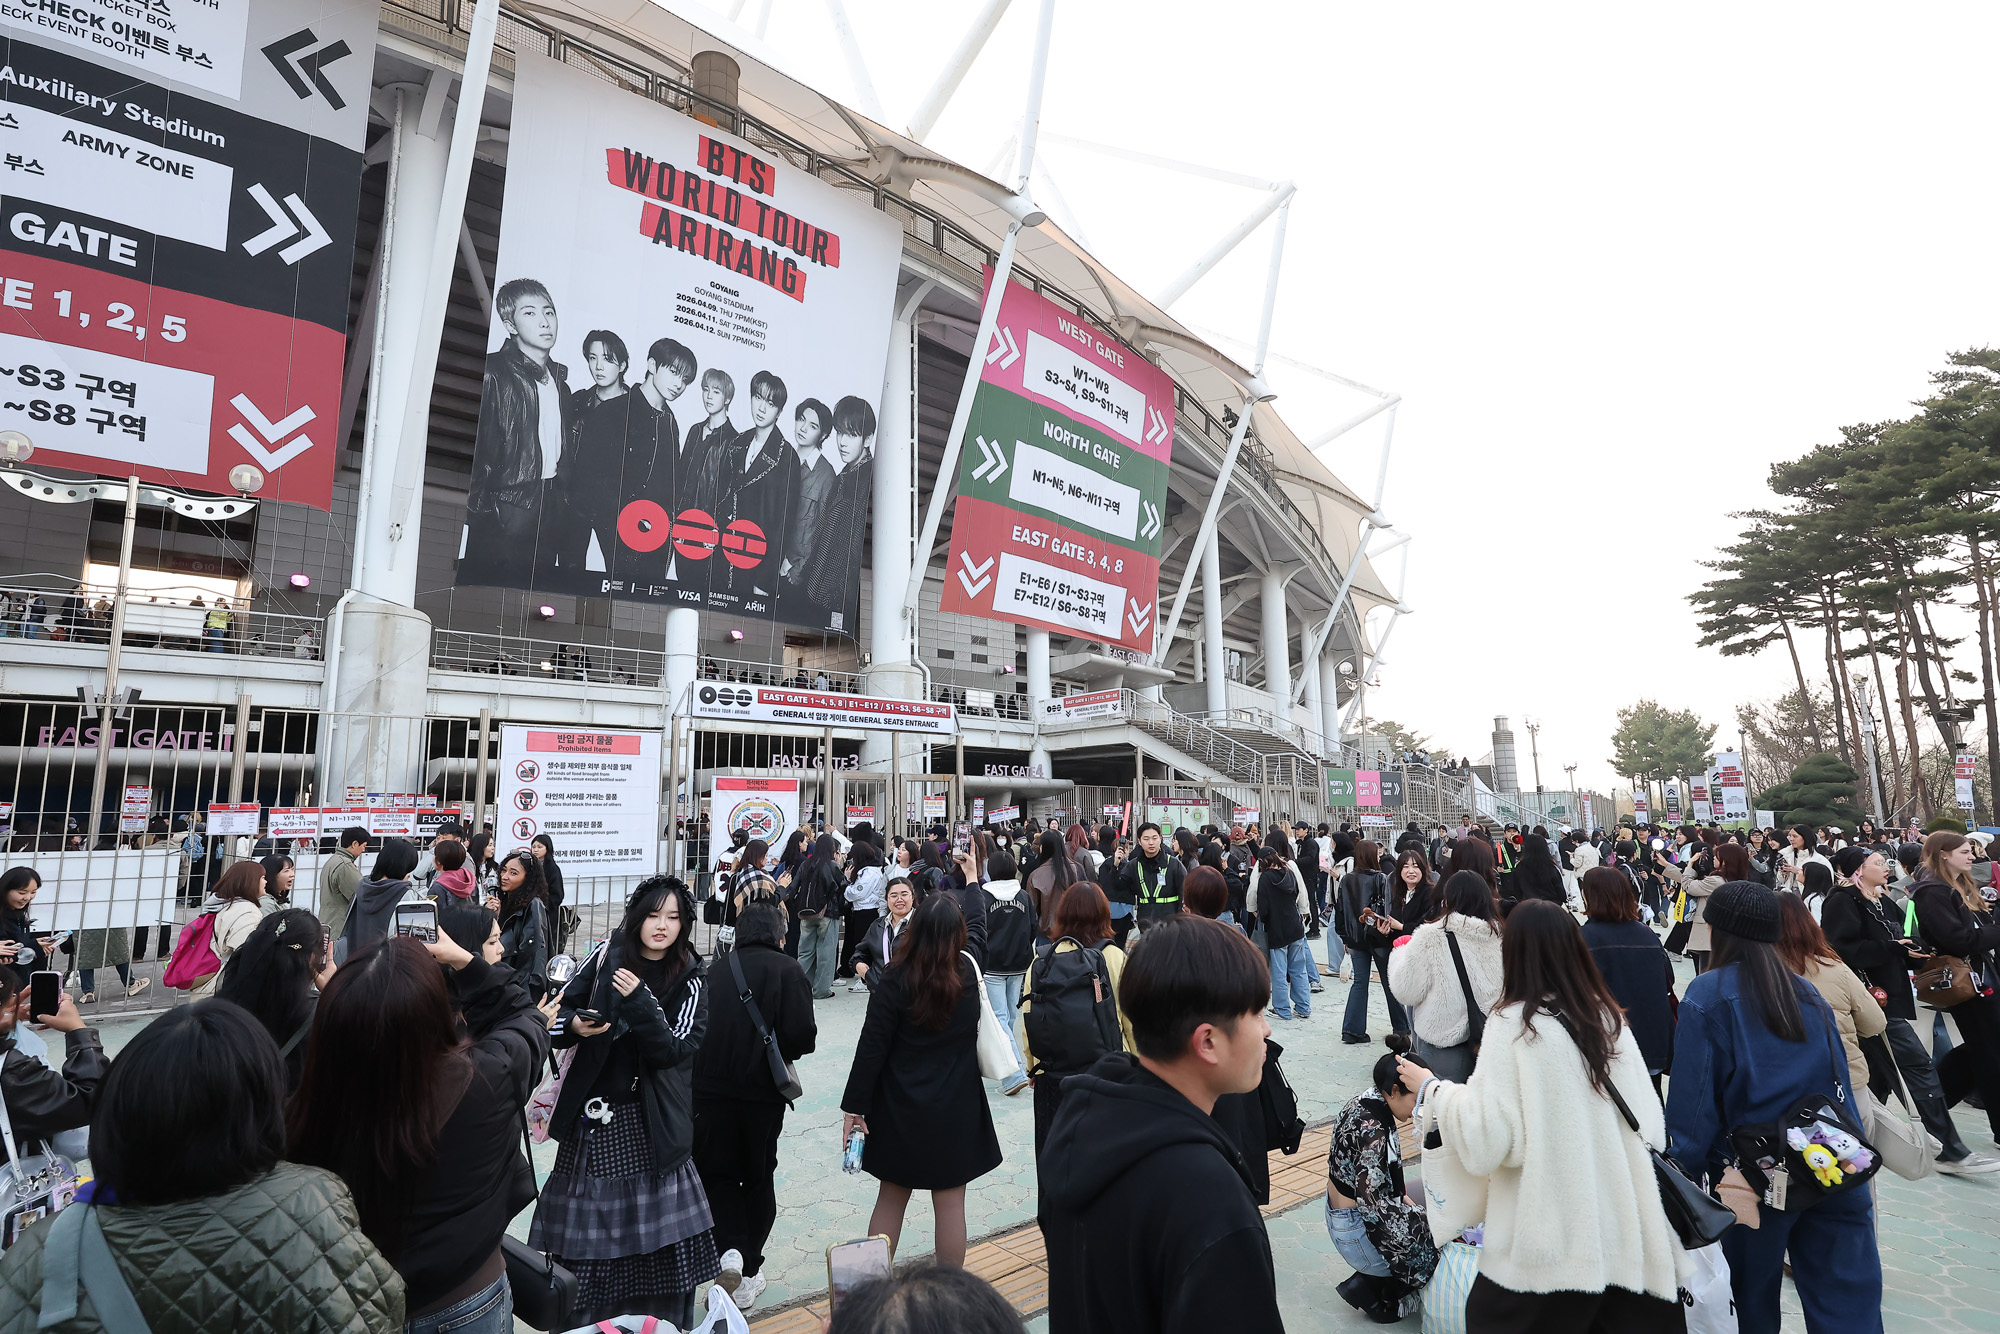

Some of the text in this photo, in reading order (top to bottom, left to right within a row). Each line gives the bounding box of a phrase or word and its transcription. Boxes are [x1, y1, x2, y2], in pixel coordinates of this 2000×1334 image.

[37, 14, 145, 60] EVENT BOOTH
[146, 13, 177, 34] BOX
[112, 21, 213, 69] 이벤트 부스
[0, 65, 226, 149] Auxiliary Stadium
[4, 153, 45, 176] 부스
[62, 129, 195, 180] ARMY ZONE
[706, 138, 766, 195] BTS
[624, 146, 828, 268] WORLD TOUR
[10, 211, 138, 268] GATE
[652, 208, 798, 294] ARIRANG
[694, 286, 754, 313] GOYANG STADIUM
[710, 280, 740, 298] GOYANG
[53, 290, 188, 343] 1, 2, 5
[676, 292, 768, 330] 2026.04.09. THU 7PM(KST)
[676, 304, 766, 340] 2026.04.11. SAT 7PM(KST)
[674, 315, 766, 352] 2026.04.12. SUN 7PM(KST)
[1057, 316, 1124, 369] WEST GATE
[75, 373, 137, 409] 구역
[1044, 369, 1128, 424] S3~S4, S9~S11 구역
[1073, 365, 1110, 395] W1~W8
[86, 408, 146, 442] 구역
[1043, 420, 1121, 470] NORTH GATE
[1032, 469, 1121, 516] N1~N5, N6~N11 구역
[1012, 524, 1124, 574] EAST GATE 3, 4, 8
[676, 590, 700, 602] VISA
[708, 592, 738, 602] SAMSUNG
[708, 599, 728, 608] Galaxy
[1014, 588, 1050, 608] E7~E12
[1050, 598, 1056, 610] /
[1091, 608, 1106, 624] 구역
[1020, 572, 1050, 590] E1~E6
[1051, 580, 1058, 594] /
[1090, 592, 1104, 608] 구역
[763, 692, 784, 702] EAST
[786, 695, 808, 704] GATE
[810, 697, 828, 707] 1~4,
[829, 699, 836, 707] 5,
[848, 700, 878, 710] E1~E12
[885, 703, 911, 713] S1~S3,
[912, 706, 934, 714] S6~S8
[936, 707, 947, 716] 구역
[816, 713, 828, 721] 입장
[848, 715, 881, 724] GENERAL
[883, 717, 904, 726] SEATS
[905, 718, 939, 728] ENTRANCE
[38, 726, 213, 750] EAST GATE
[557, 734, 613, 745] 반입 금지 물품
[772, 754, 859, 770] EAST 3
[984, 764, 1044, 778] EAST GATE 4
